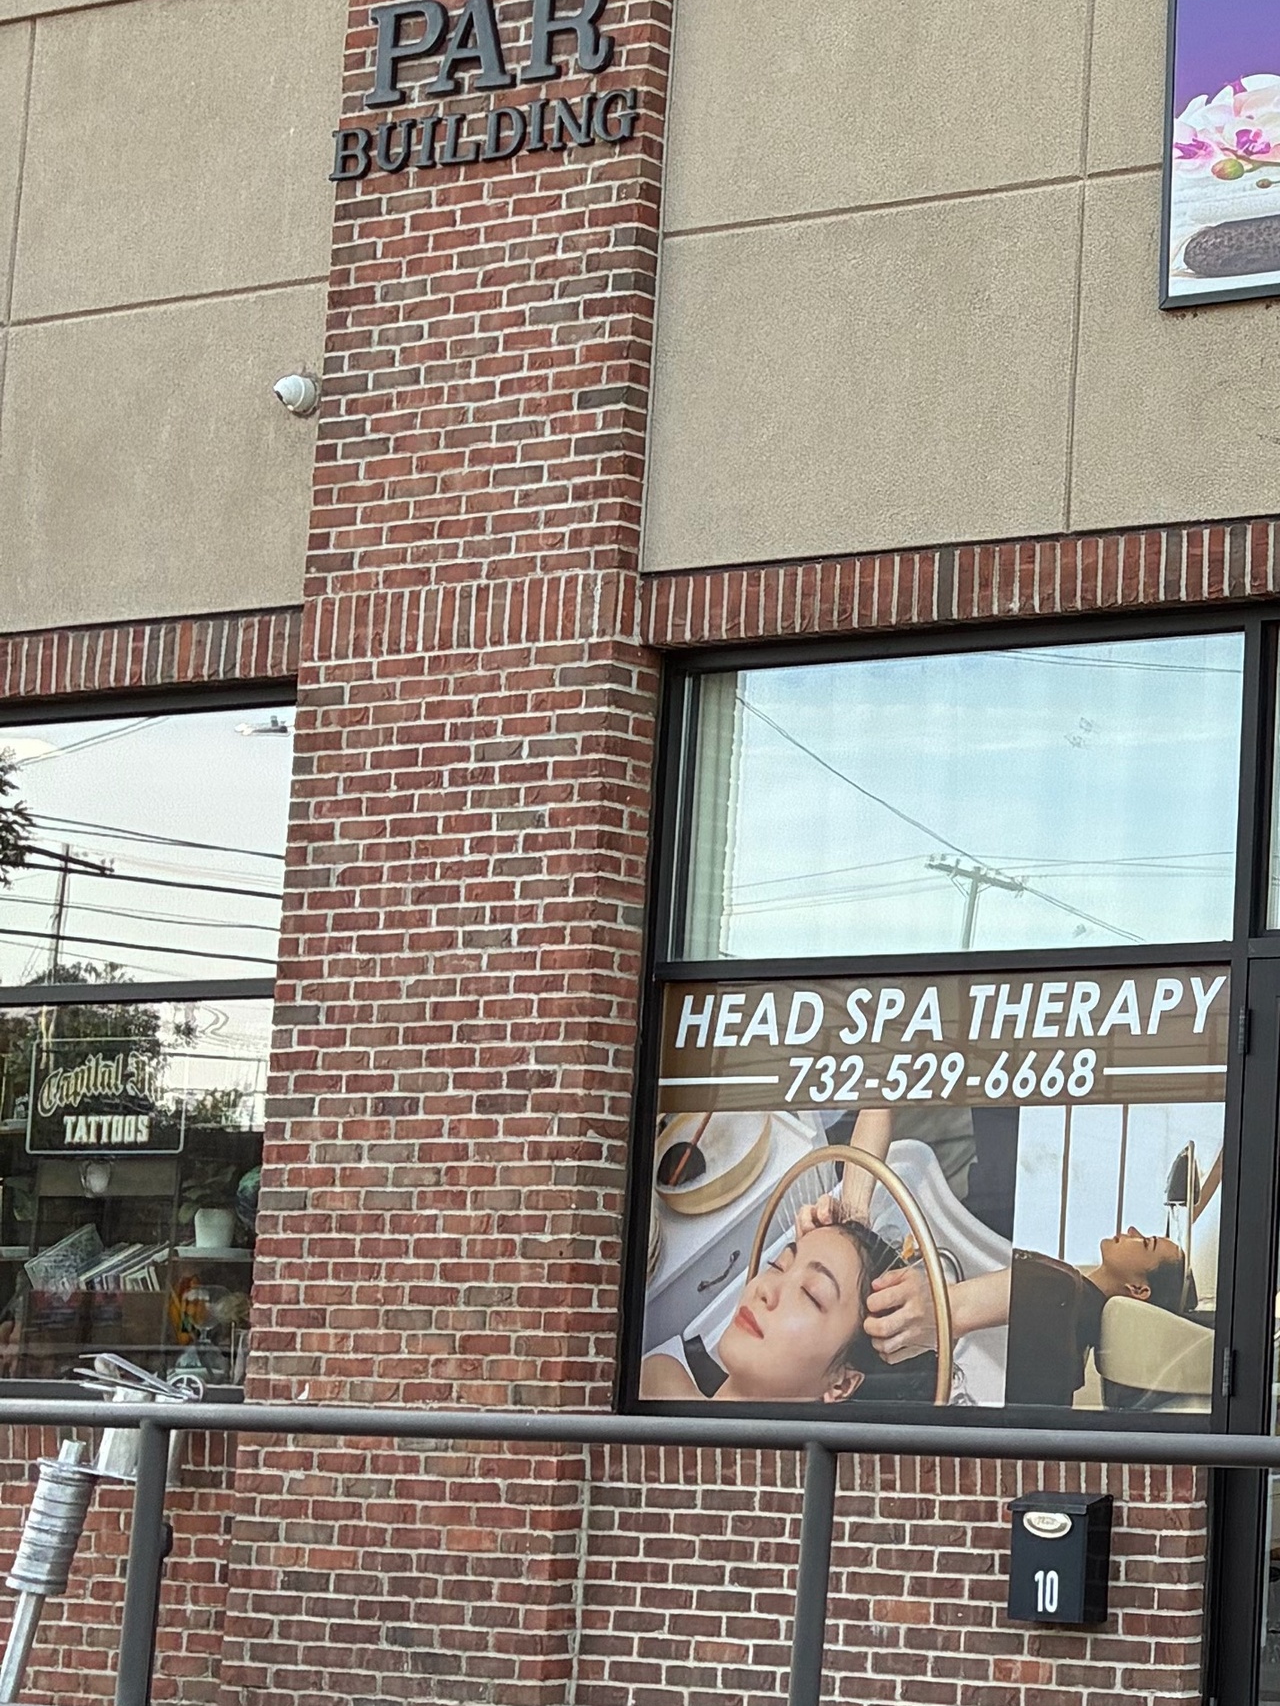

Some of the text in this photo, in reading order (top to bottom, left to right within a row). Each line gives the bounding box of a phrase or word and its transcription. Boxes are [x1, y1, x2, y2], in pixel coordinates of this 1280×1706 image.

[328, 88, 642, 182] BUILDING
[674, 975, 1228, 1049] HEAD SPA THERAPY
[783, 1048, 1098, 1103] 732-529-6668
[63, 1114, 150, 1144] TATTOOS
[1034, 1569, 1059, 1613] 10
